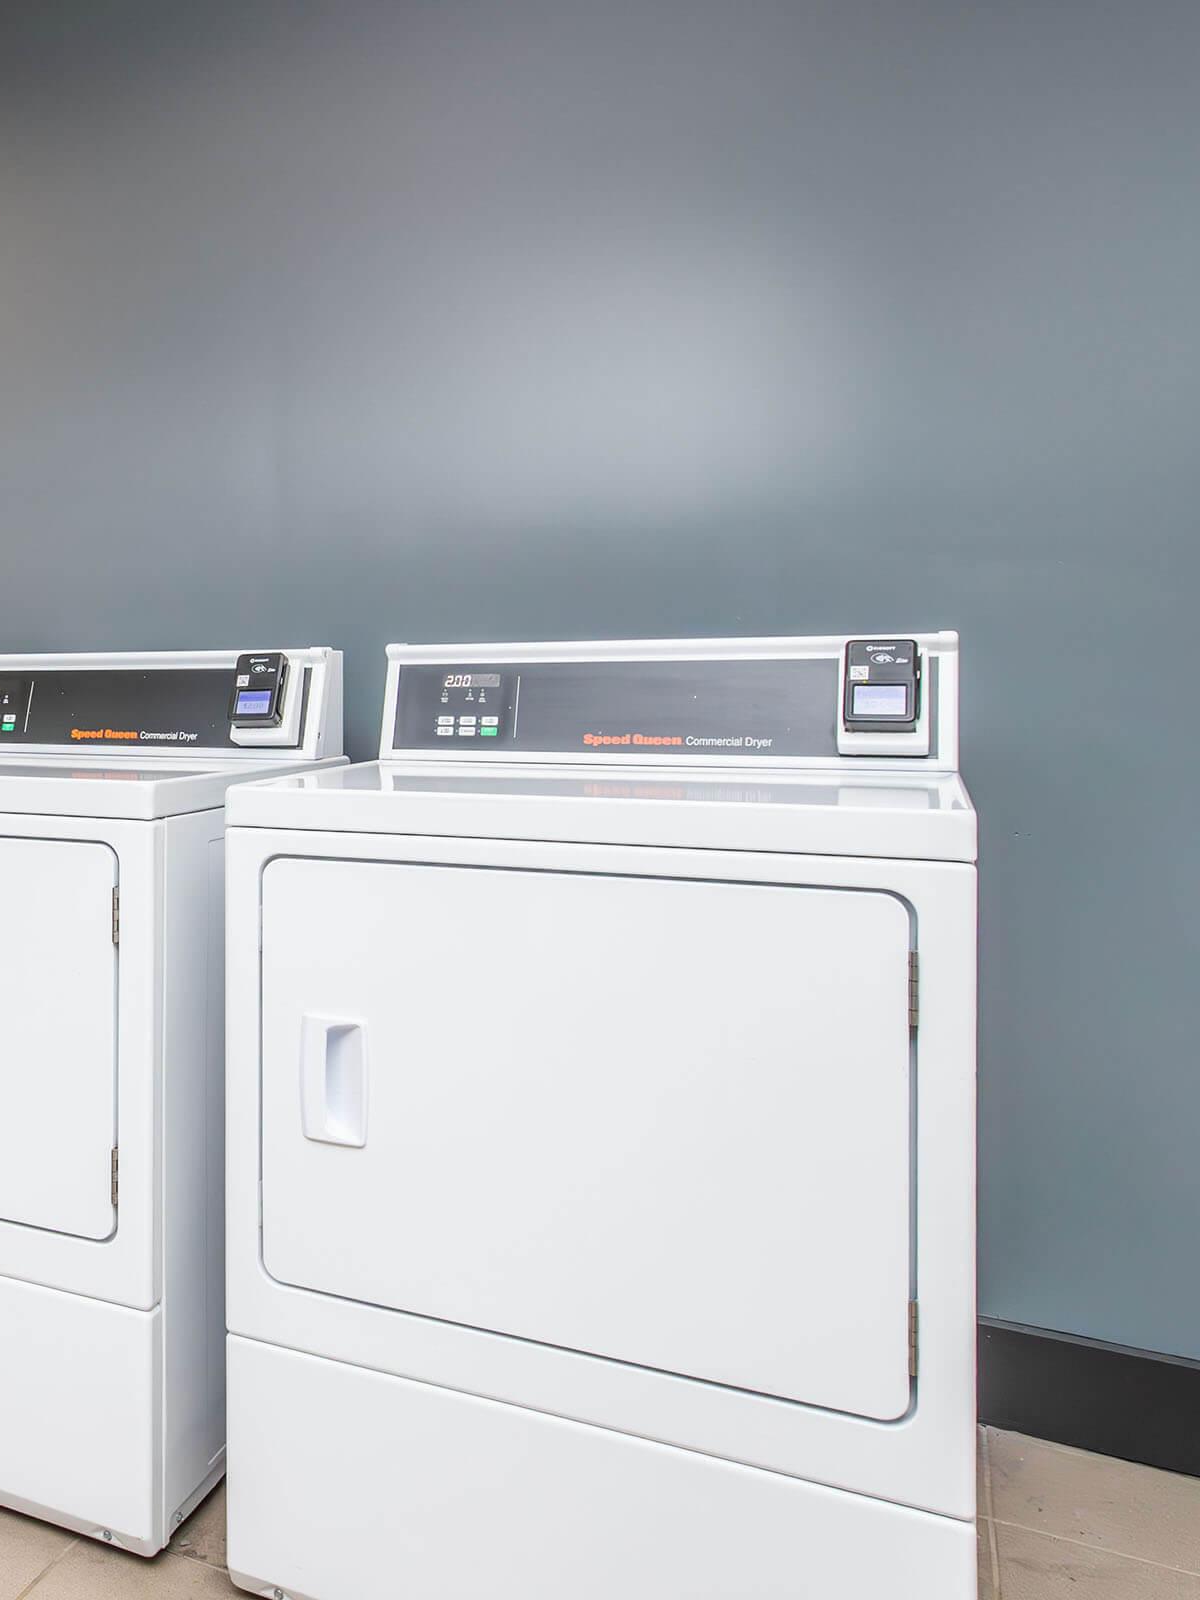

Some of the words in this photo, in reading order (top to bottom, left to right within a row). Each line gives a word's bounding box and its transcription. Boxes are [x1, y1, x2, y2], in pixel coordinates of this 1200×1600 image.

[71, 729, 103, 740] Speed
[104, 729, 137, 739] Queen
[140, 731, 178, 740] Commercial
[179, 731, 198, 742] Dryer
[583, 733, 631, 746] Speed
[632, 734, 682, 746] Queen
[685, 736, 743, 746] Commercial
[745, 737, 773, 749] Dryer
